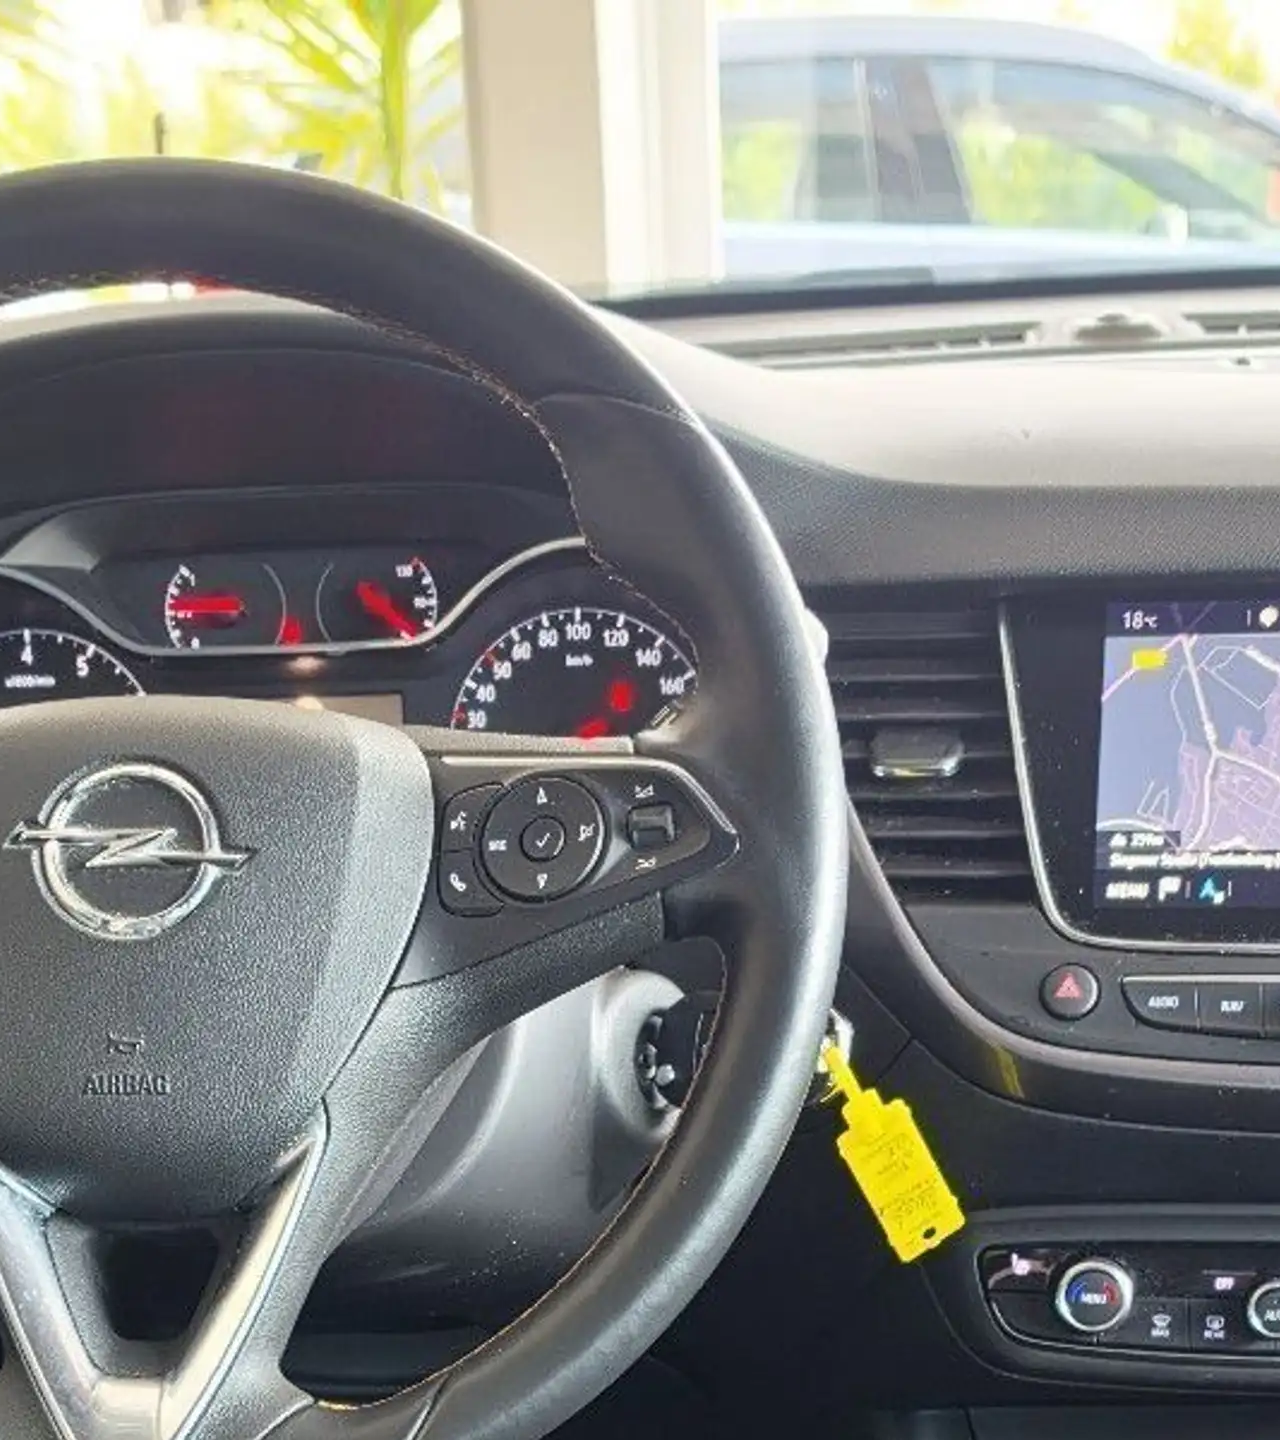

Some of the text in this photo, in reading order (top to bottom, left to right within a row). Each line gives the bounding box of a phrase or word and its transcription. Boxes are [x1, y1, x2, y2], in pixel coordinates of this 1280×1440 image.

[538, 628, 559, 648] 80
[565, 621, 592, 641] 100
[602, 628, 630, 648] 120
[20, 645, 34, 666] 4
[511, 640, 532, 661] 60
[634, 647, 662, 667] 140
[76, 653, 90, 677] 5
[493, 660, 513, 681] 50
[475, 683, 496, 703] 40
[659, 675, 685, 696] 160
[467, 709, 488, 729] 30
[81, 1074, 170, 1096] AIRBAG
